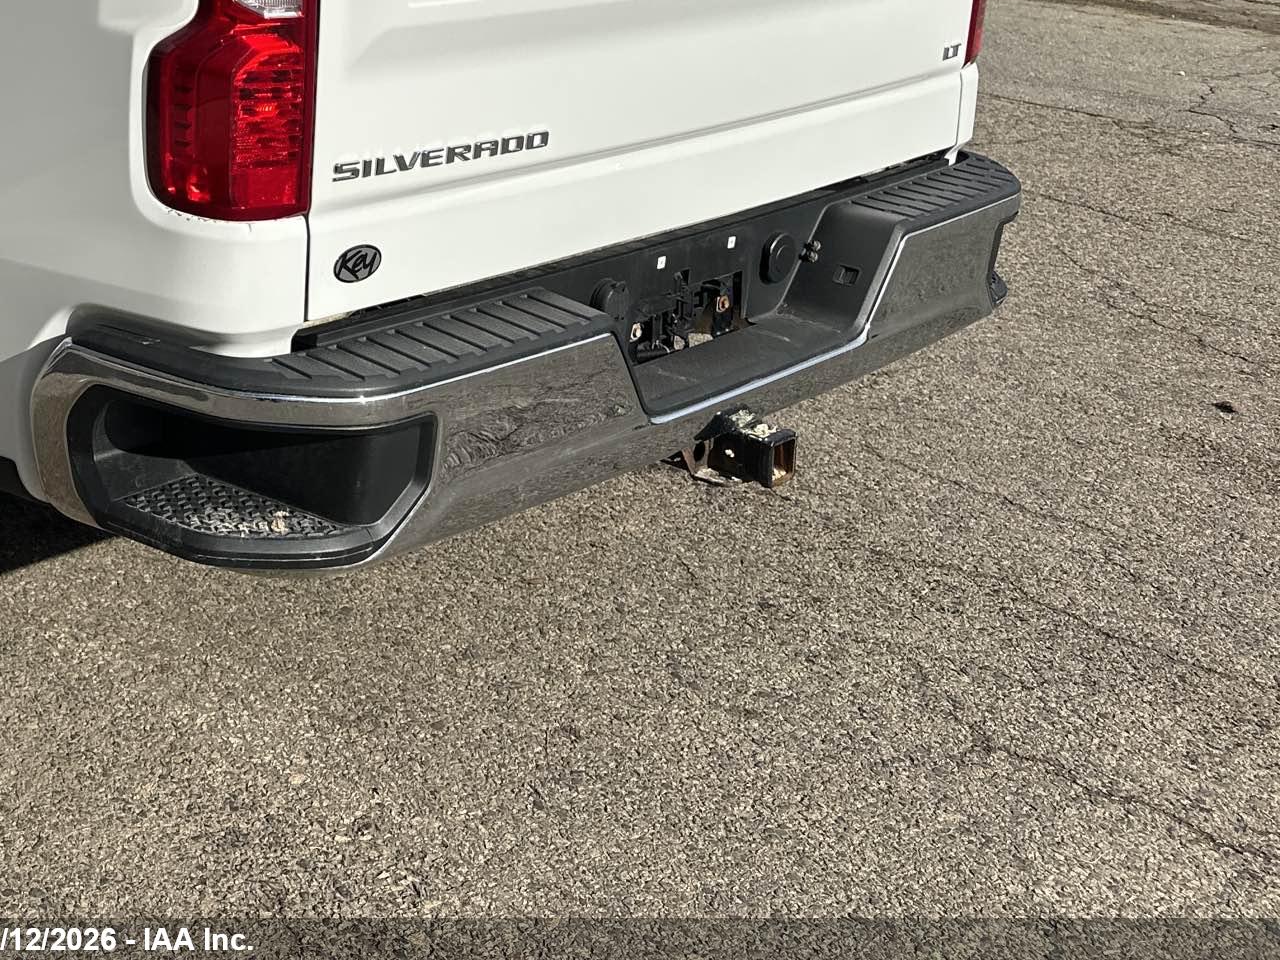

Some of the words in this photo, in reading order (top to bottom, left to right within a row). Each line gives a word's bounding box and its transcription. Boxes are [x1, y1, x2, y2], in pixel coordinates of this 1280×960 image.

[942, 43, 962, 61] LT
[331, 130, 550, 182] SILVERADO
[336, 248, 378, 280] Key
